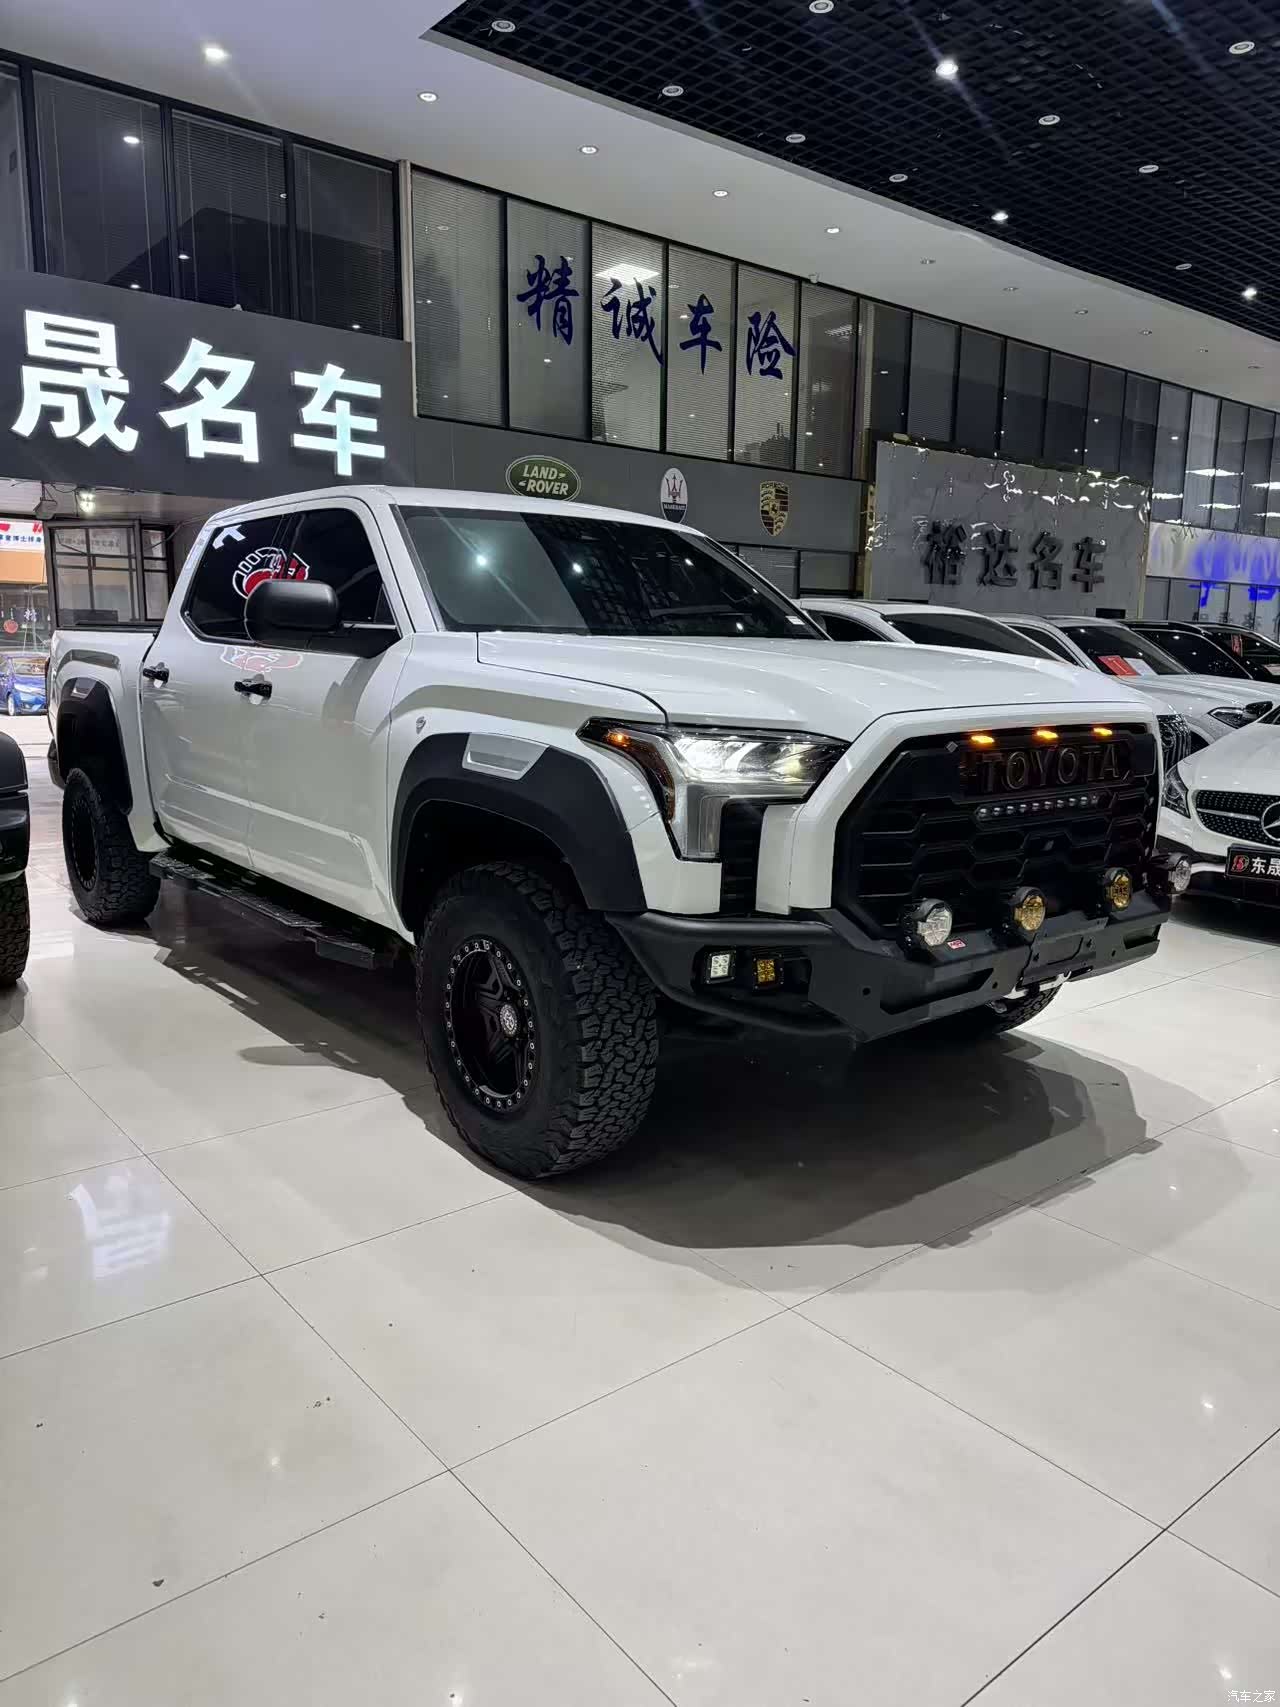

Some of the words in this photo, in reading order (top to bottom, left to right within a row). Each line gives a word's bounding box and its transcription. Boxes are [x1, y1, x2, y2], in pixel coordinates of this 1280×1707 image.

[517, 254, 797, 380] 精诚车险
[10, 309, 386, 477] 晟名车
[522, 464, 558, 480] LAND
[526, 478, 569, 496] ROVER
[980, 743, 1121, 794] TOYOTA
